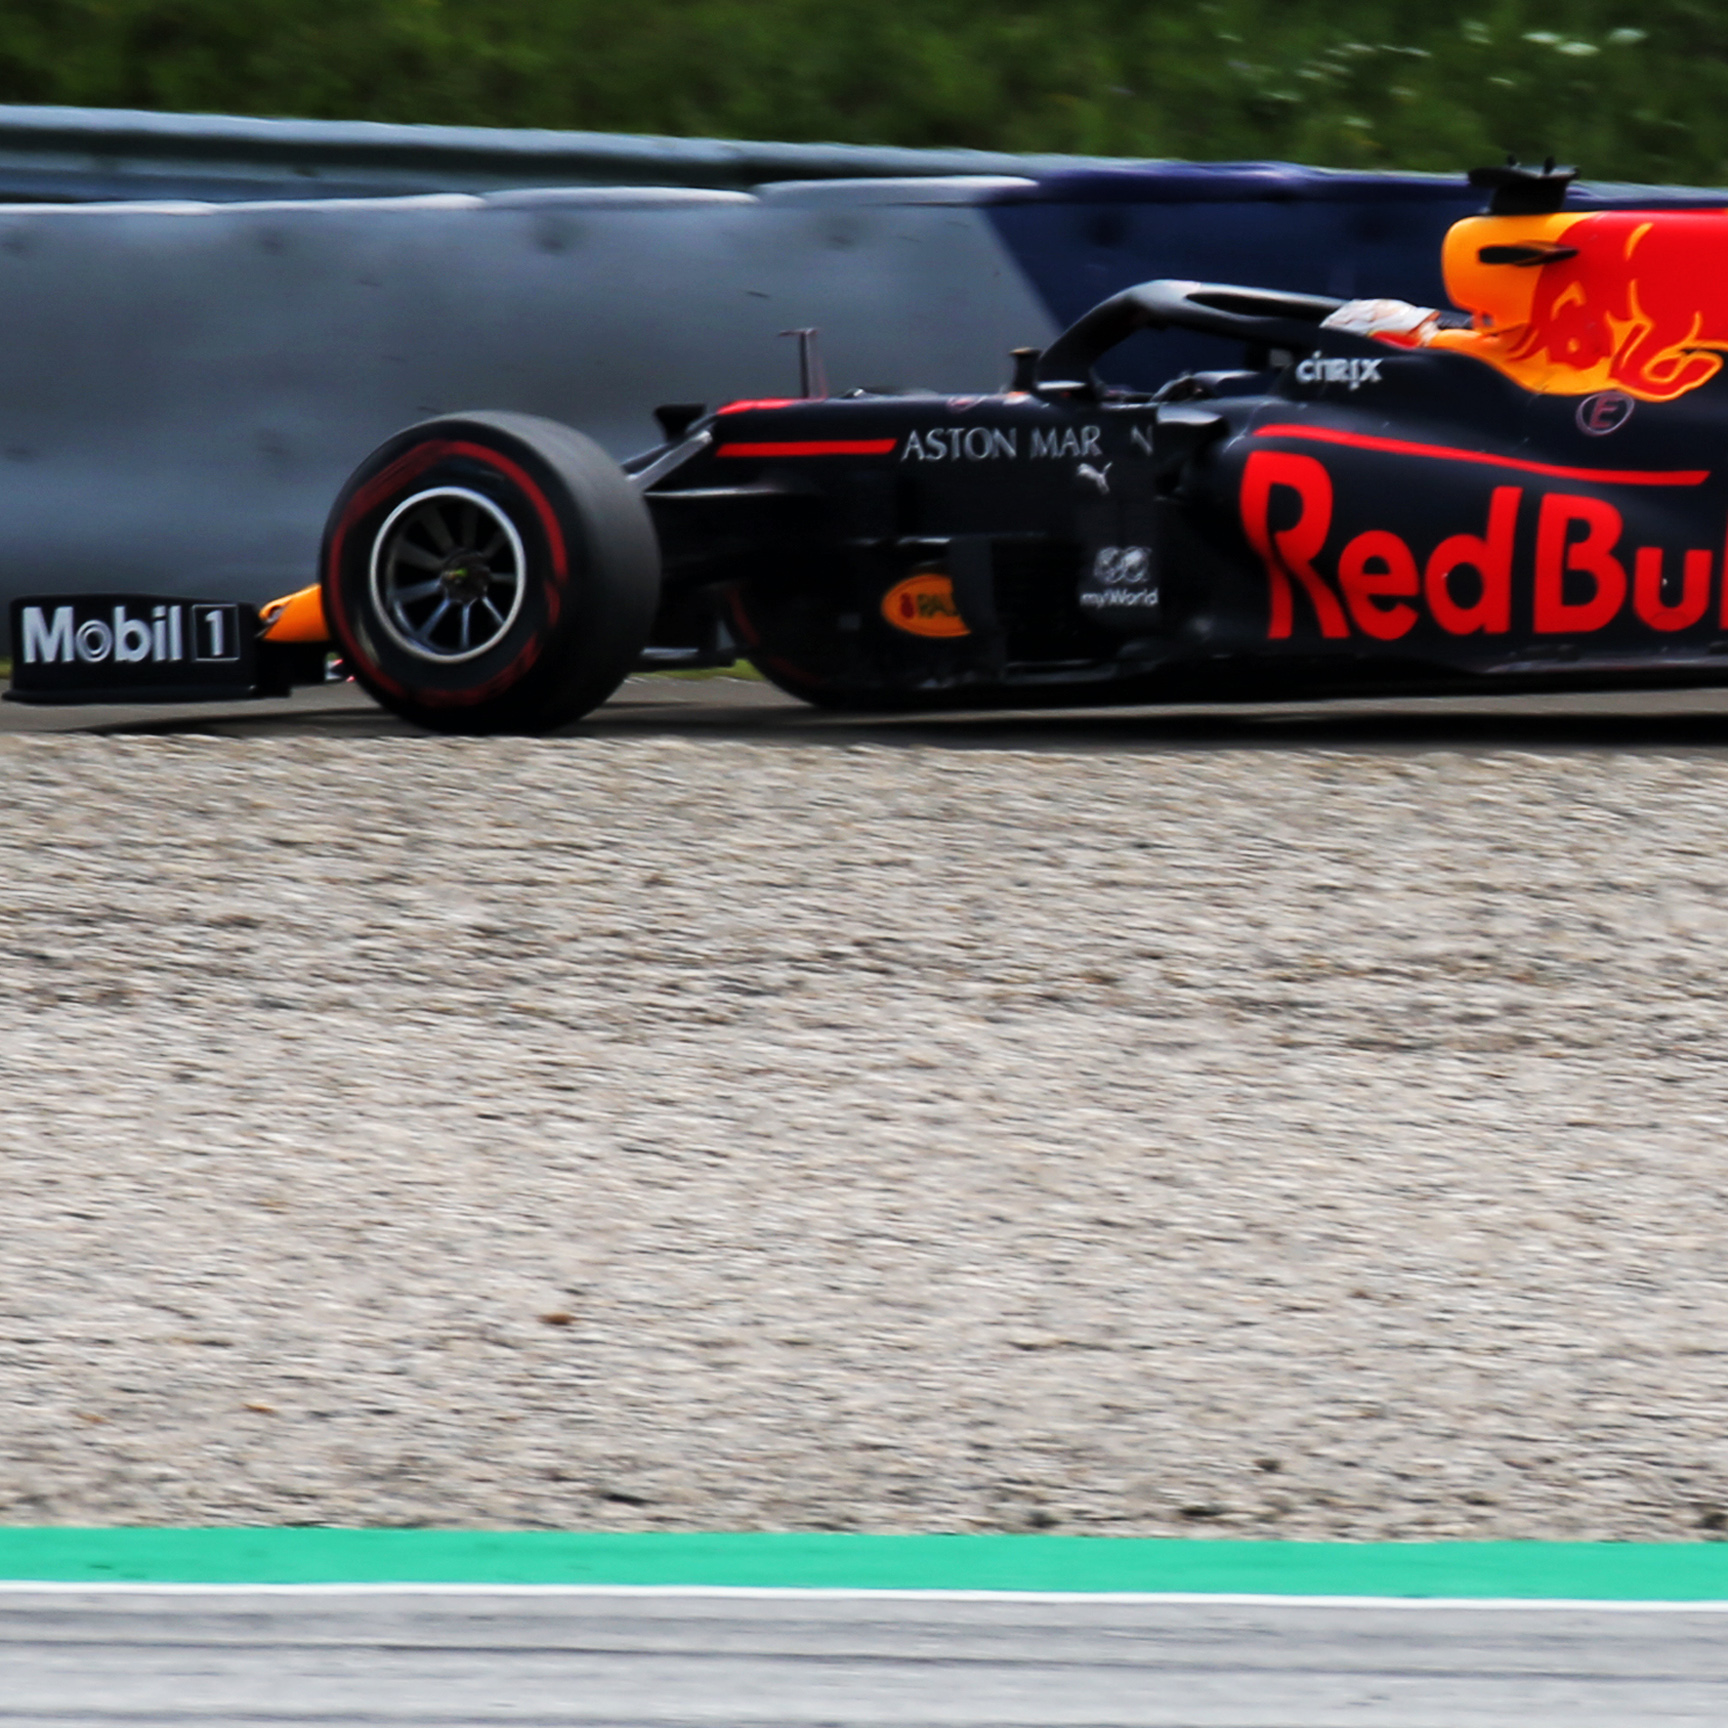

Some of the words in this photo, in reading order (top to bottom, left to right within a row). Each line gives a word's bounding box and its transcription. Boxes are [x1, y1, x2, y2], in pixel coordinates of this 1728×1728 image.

[900, 427, 1017, 463] ASTON
[1030, 425, 1154, 460] MARN
[1239, 450, 1524, 640] Red
[1080, 588, 1158, 608] myWorld
[23, 605, 182, 663] Mobil
[205, 609, 223, 656] 1
